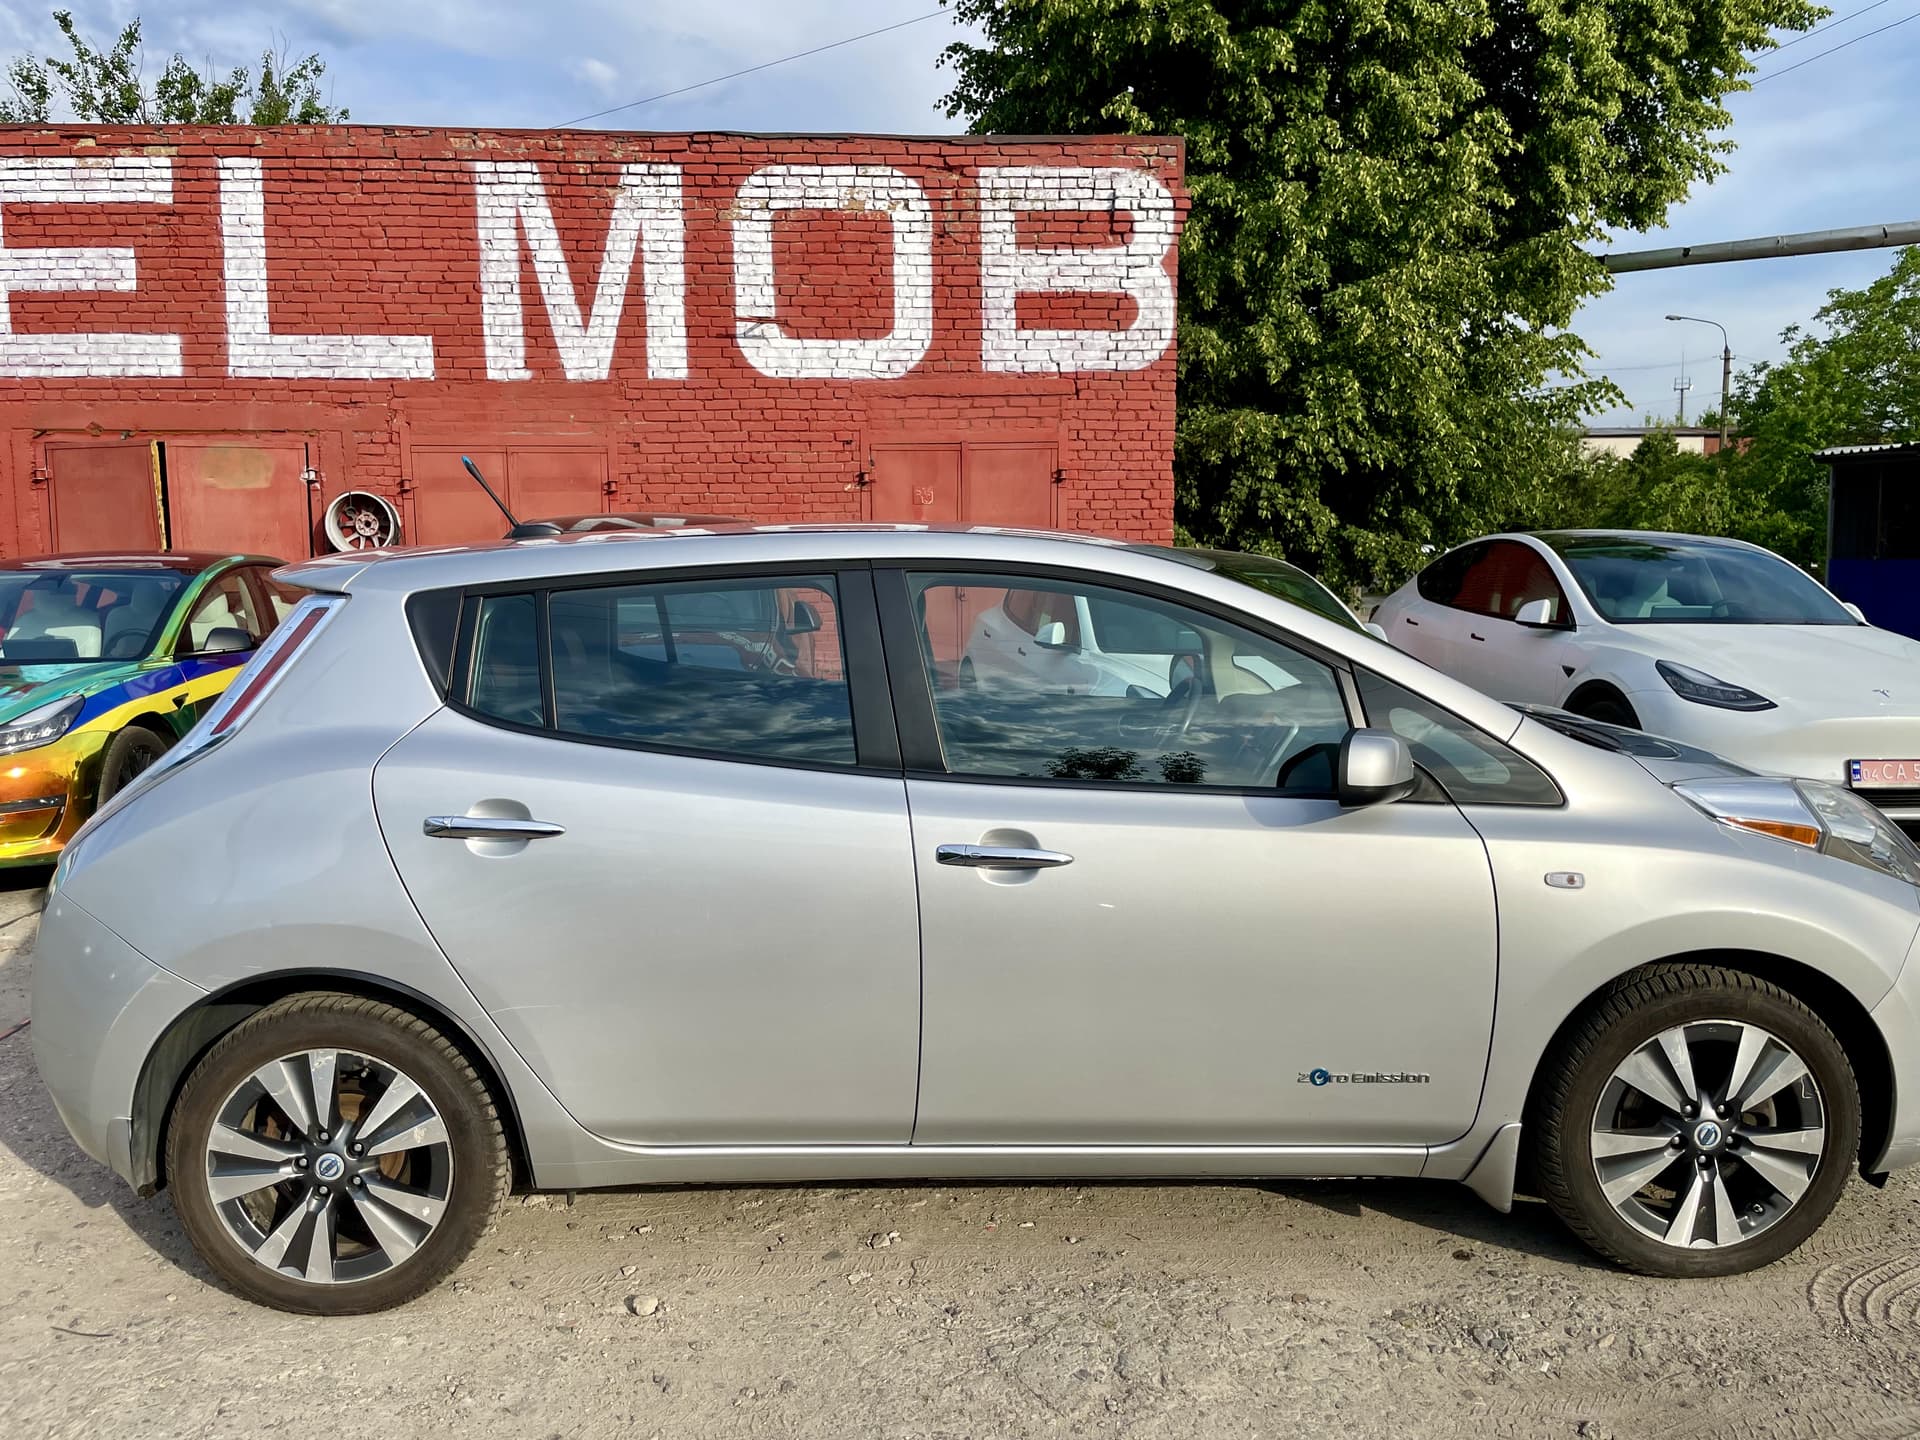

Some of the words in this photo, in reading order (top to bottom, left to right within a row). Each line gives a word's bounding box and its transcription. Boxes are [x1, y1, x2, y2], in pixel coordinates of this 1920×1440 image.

[1862, 768, 1879, 780] 04
[1882, 763, 1908, 780] CA
[1351, 1072, 1430, 1083] Emission
